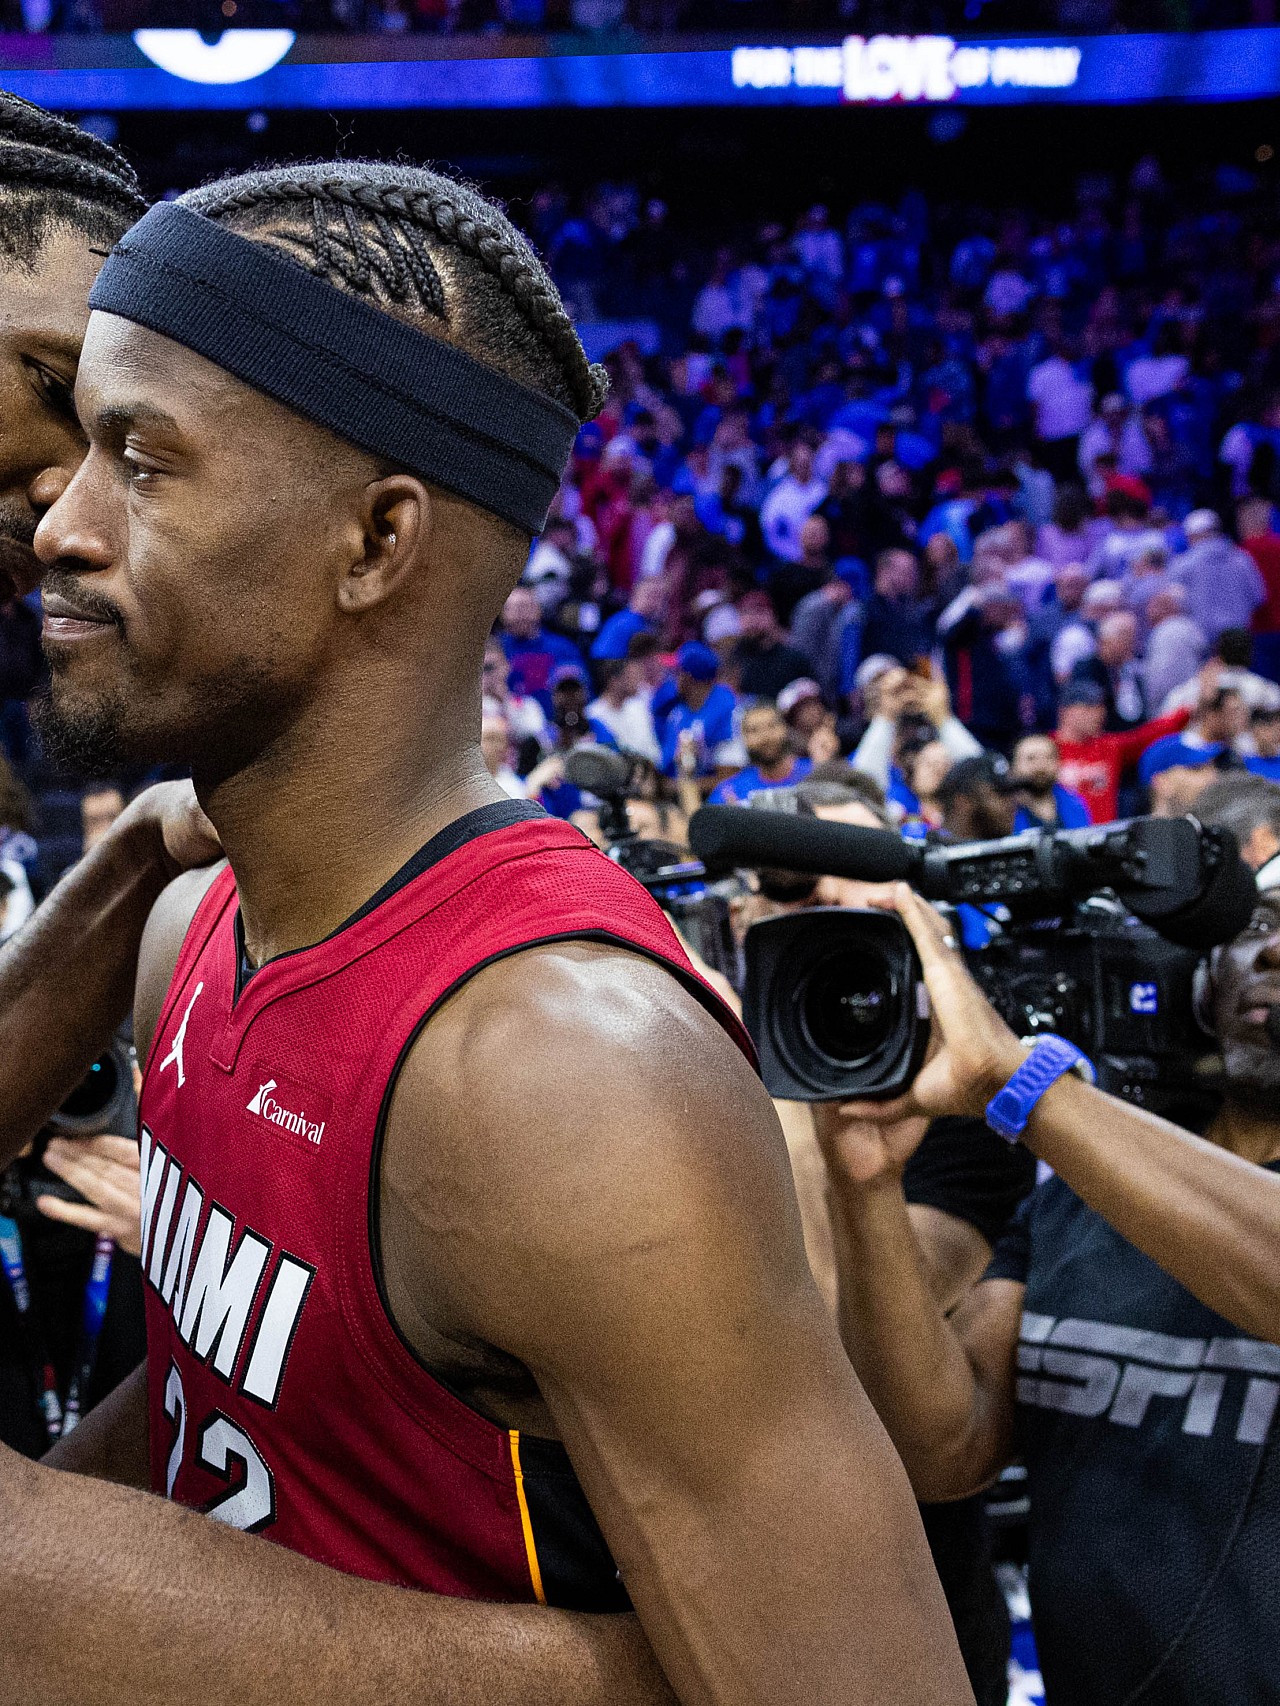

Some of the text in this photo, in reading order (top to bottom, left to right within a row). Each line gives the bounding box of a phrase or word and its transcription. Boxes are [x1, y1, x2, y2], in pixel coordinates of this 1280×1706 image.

[843, 36, 957, 99] LOVE
[263, 1098, 325, 1145] Carnival
[140, 1123, 318, 1412] MIAMI
[163, 1354, 278, 1534] 22
